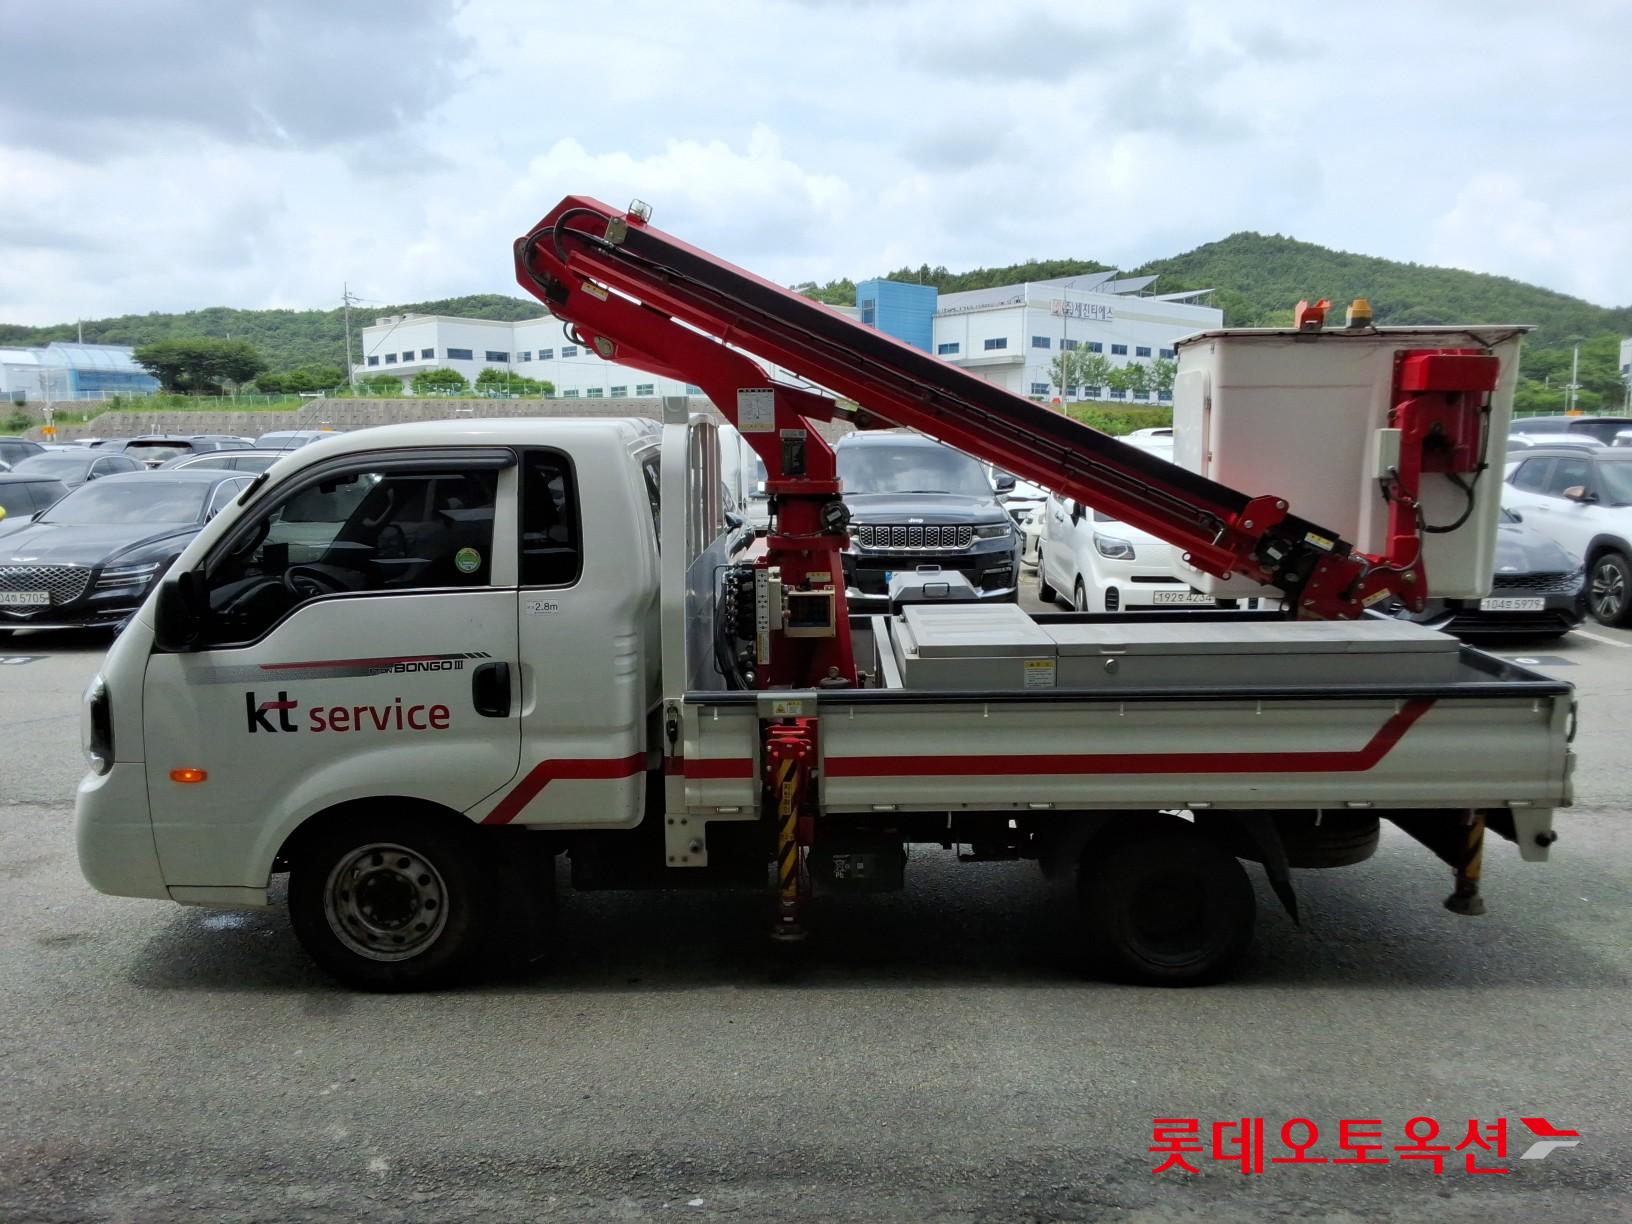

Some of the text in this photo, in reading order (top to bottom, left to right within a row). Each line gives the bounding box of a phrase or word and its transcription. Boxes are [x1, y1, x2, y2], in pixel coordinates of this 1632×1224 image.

[20, 593, 45, 603] 5705
[535, 602, 558, 611] 2.8m
[394, 661, 452, 673] BONGO
[246, 691, 450, 733] kt service
